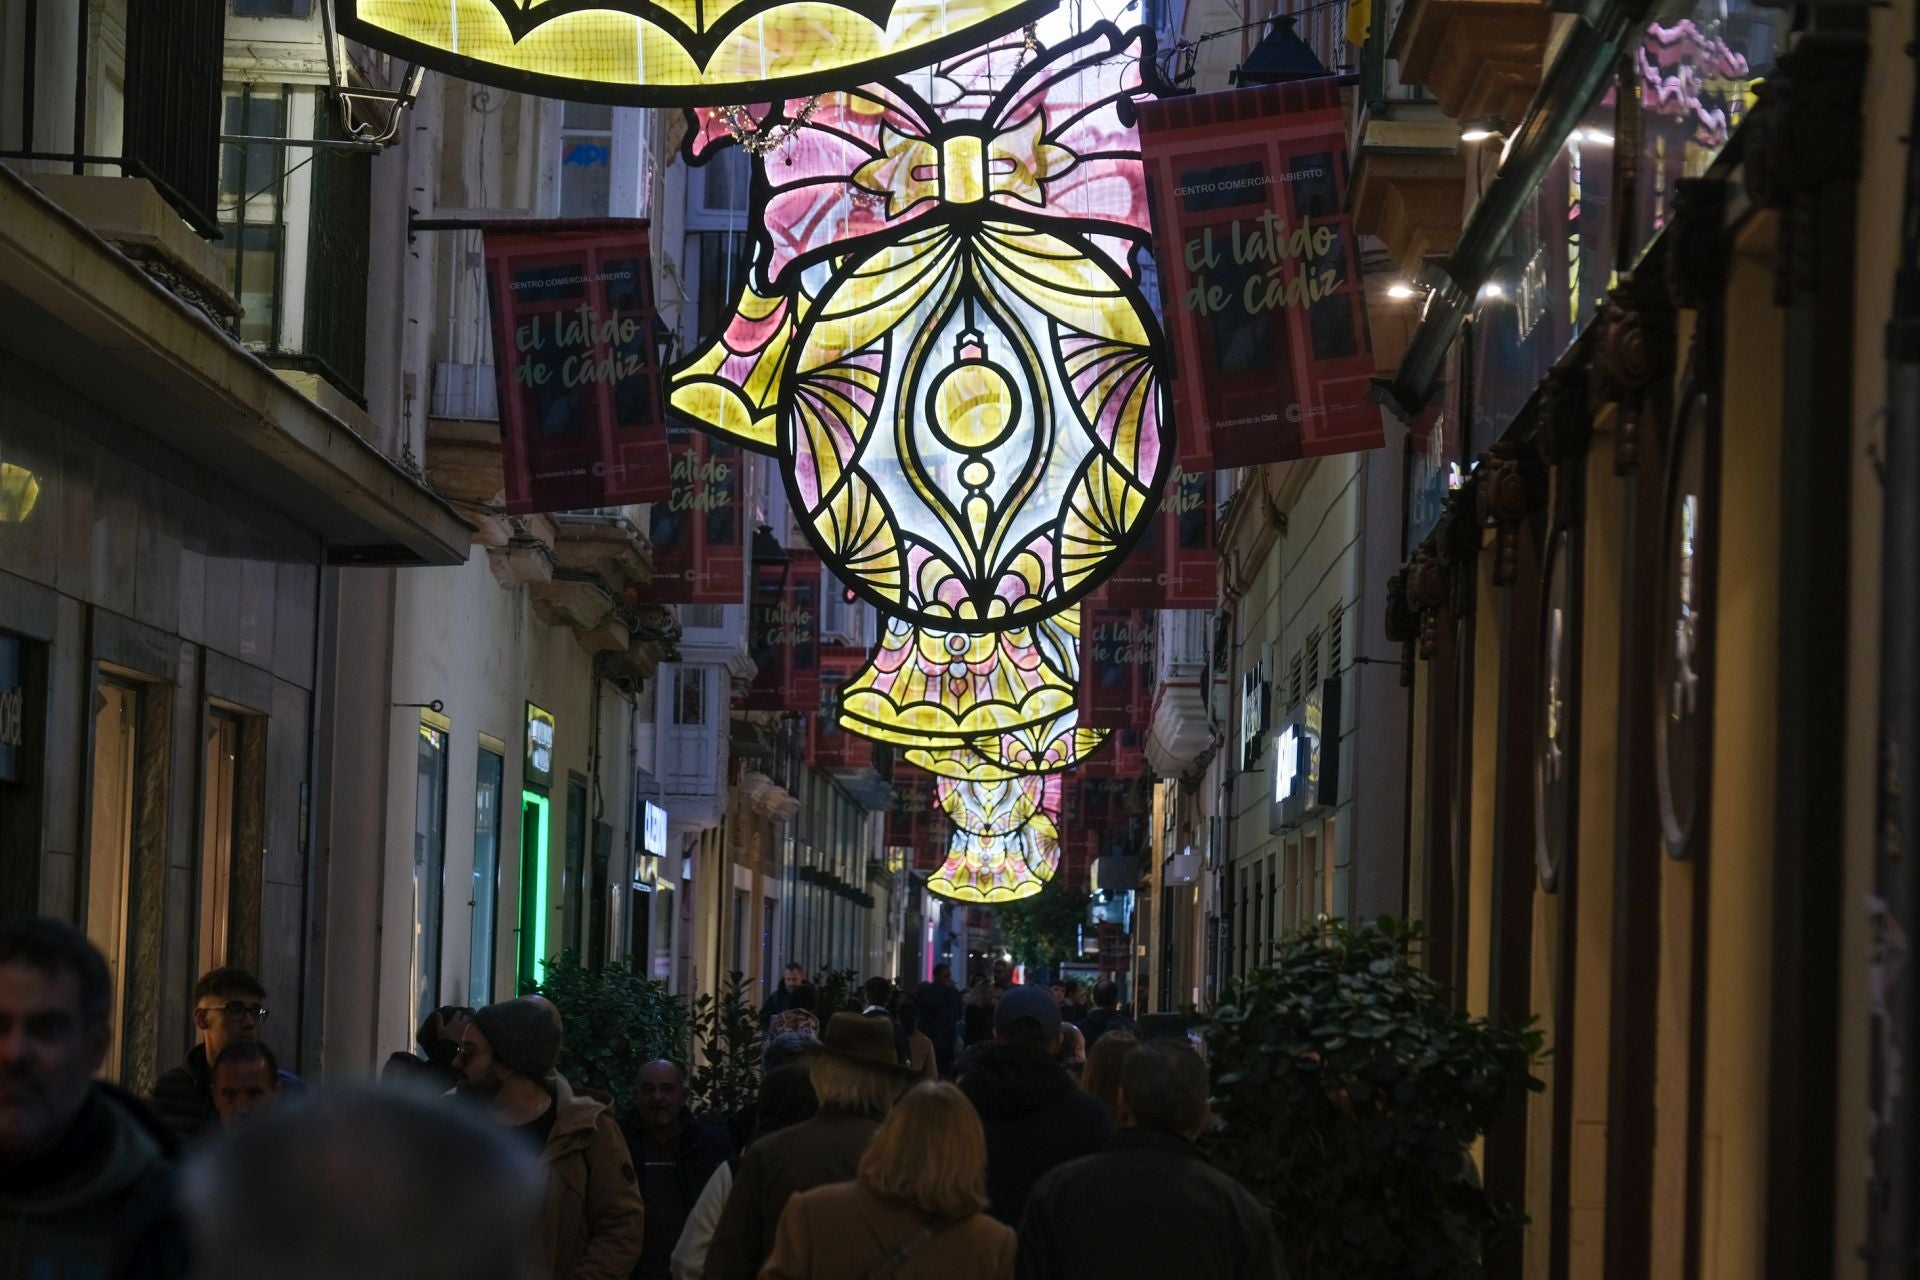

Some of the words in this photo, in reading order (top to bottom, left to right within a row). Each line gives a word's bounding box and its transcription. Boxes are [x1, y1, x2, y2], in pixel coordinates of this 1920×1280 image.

[1174, 183, 1216, 197] CENTRO
[1217, 175, 1278, 191] COMERCIAL
[1279, 168, 1324, 183] ABIERTO
[1184, 226, 1221, 272] El
[1231, 208, 1338, 266] latido
[509, 279, 544, 290] CENTRO
[545, 274, 593, 287] COMERCIAL
[594, 271, 632, 283] ABIERTO
[1183, 274, 1232, 317] de
[1243, 261, 1344, 315] Cádiz
[516, 315, 546, 352] El
[555, 302, 641, 348] latido
[514, 354, 554, 389] de
[562, 347, 645, 388] Cádiz
[668, 483, 732, 514] Cádiz
[767, 626, 812, 647] Cádiz
